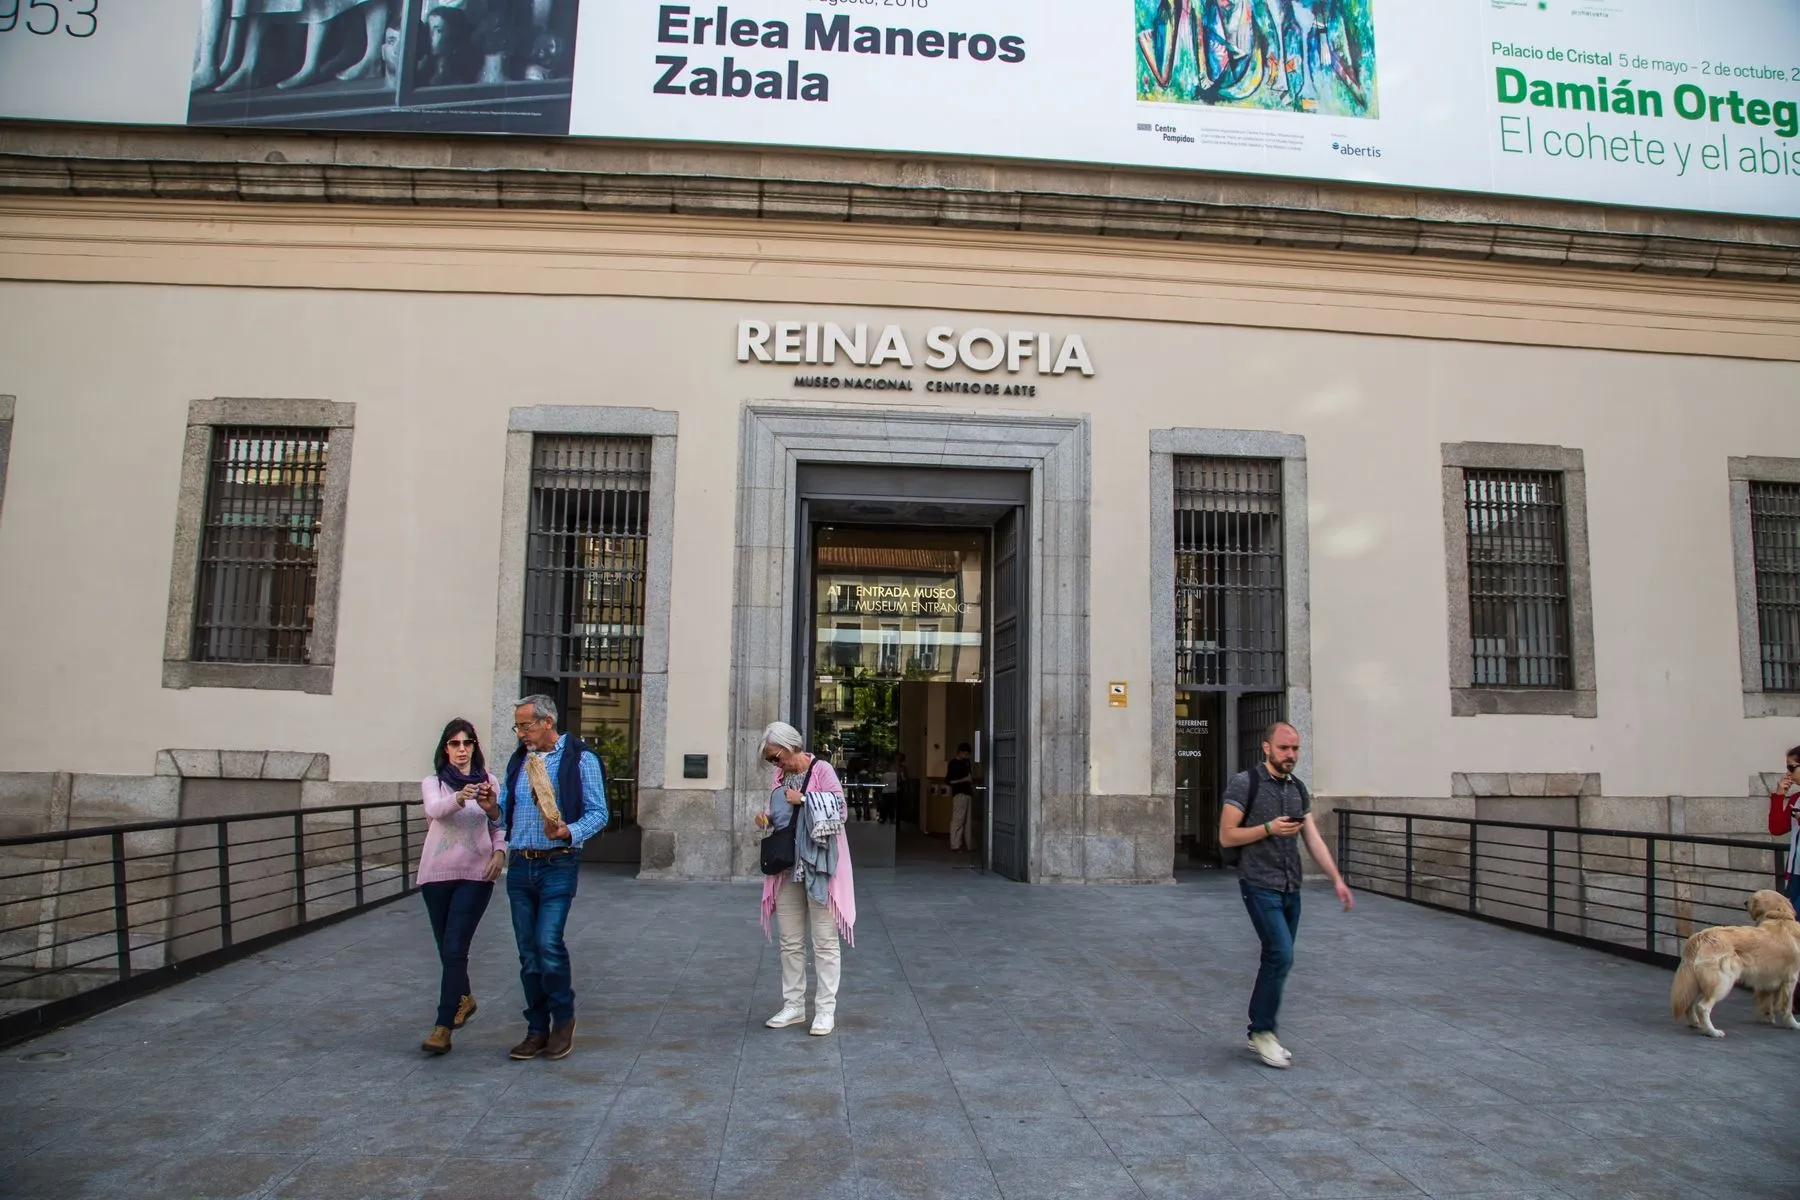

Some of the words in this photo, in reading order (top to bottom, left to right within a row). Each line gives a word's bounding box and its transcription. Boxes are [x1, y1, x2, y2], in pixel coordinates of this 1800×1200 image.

[658, 5, 788, 49] Erlea
[805, 13, 1026, 63] Maneros
[1492, 42, 1543, 59] Palacio
[1546, 47, 1564, 61] de
[1567, 49, 1612, 66] Cristal
[1619, 54, 1629, 67] 5
[1632, 55, 1648, 69] de
[1652, 60, 1688, 75] mayo
[1701, 61, 1710, 75] 2
[1714, 62, 1731, 76] de
[1734, 65, 1788, 82] octubre,
[653, 55, 829, 102] Zabala
[1496, 67, 1663, 117] Damián
[1673, 84, 1799, 138] Orteg
[1155, 124, 1177, 133] Centre
[1163, 134, 1195, 144] Pompidou
[1340, 144, 1381, 157] abertis
[1500, 116, 1532, 154] El
[1543, 122, 1665, 165] cohete
[1674, 142, 1691, 176] y
[1701, 134, 1728, 171] el
[737, 319, 914, 368] REINA
[924, 326, 1096, 377] SOFIA
[794, 376, 840, 388] MUSEO
[844, 377, 913, 391] NACIONAL
[926, 381, 981, 394] CENTRO
[984, 384, 999, 395] DE
[1003, 385, 1036, 397] ARTE
[827, 586, 840, 596] A1
[856, 586, 911, 598] ENTRADA
[914, 588, 956, 599] MUSEO
[855, 600, 908, 612] MUSEUM
[911, 602, 973, 614] ENTRANCE
[1186, 727, 1209, 735] ACCESS
